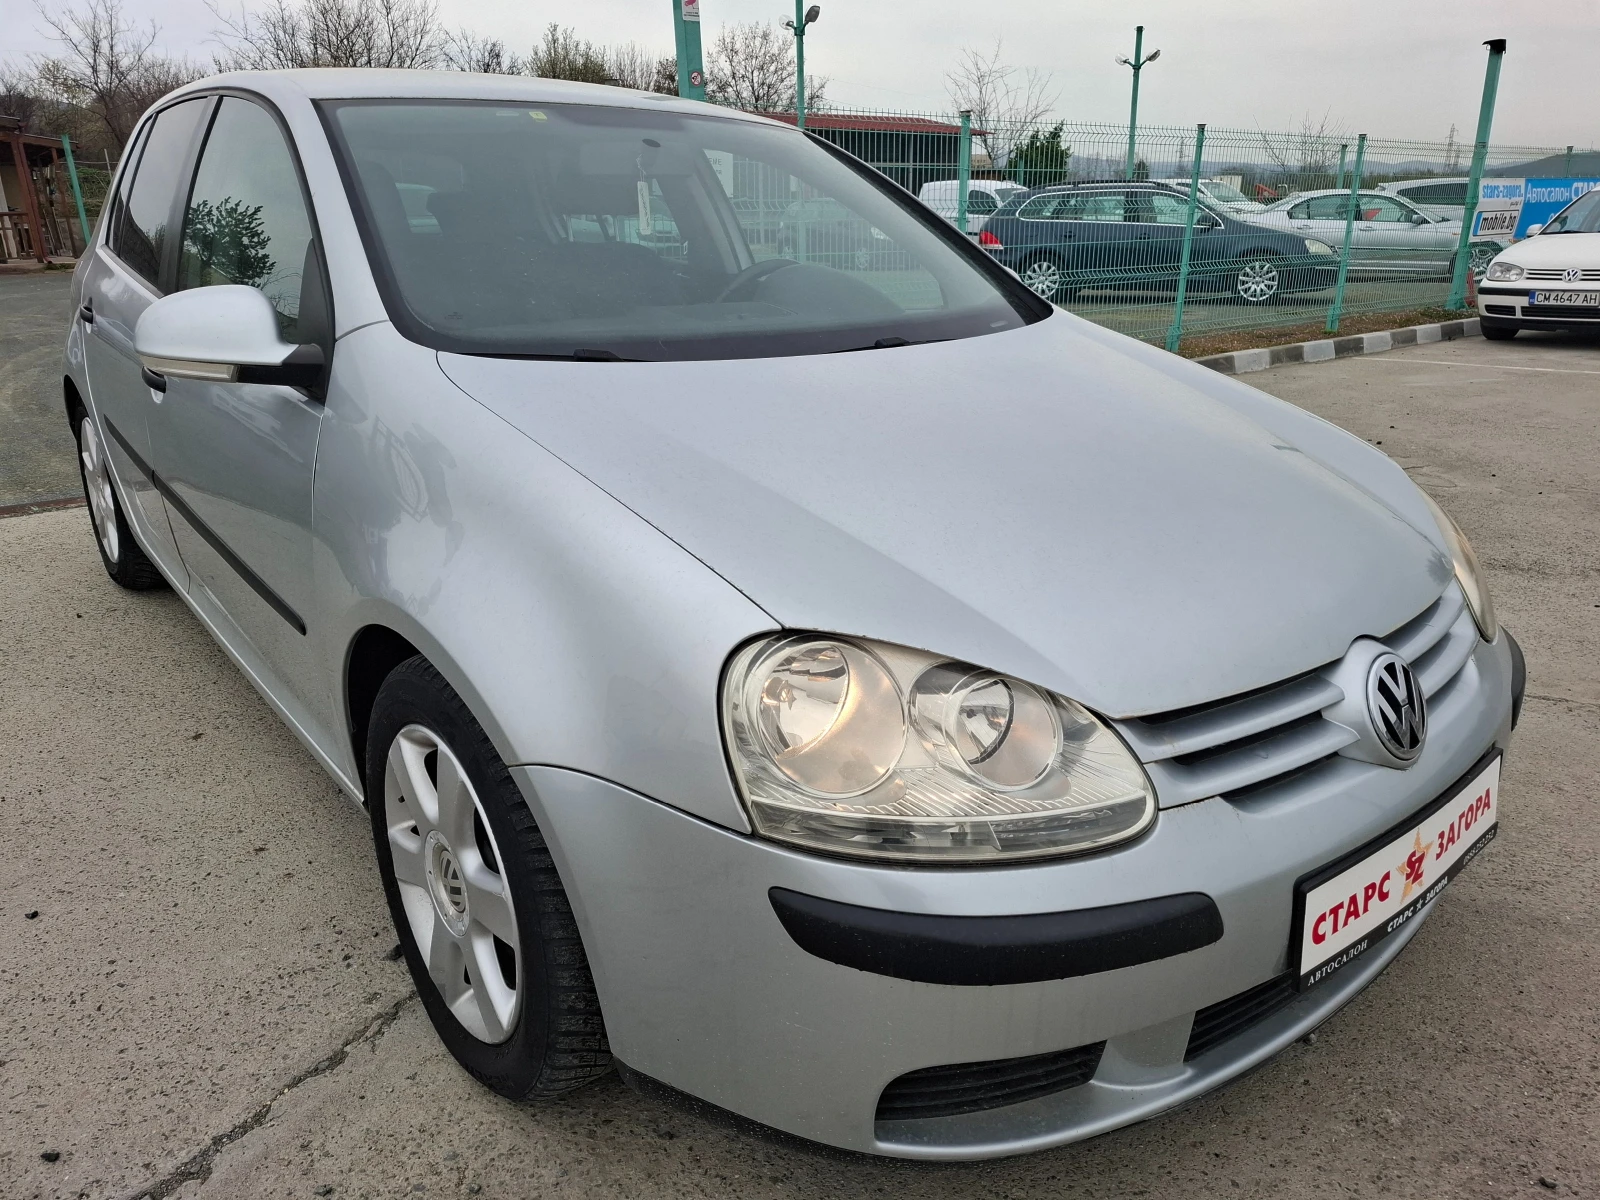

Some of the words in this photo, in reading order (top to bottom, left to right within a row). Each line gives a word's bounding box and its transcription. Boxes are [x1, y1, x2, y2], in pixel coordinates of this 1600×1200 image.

[1525, 183, 1570, 203] Автосалон
[1479, 212, 1518, 232] mobile.bg
[1552, 291, 1581, 304] 4647
[1311, 870, 1391, 945] СТАРС
[1436, 786, 1491, 861] ЗАГОРА
[1307, 939, 1369, 987] АВТОСАЛОН
[1386, 906, 1415, 933] СТАРС
